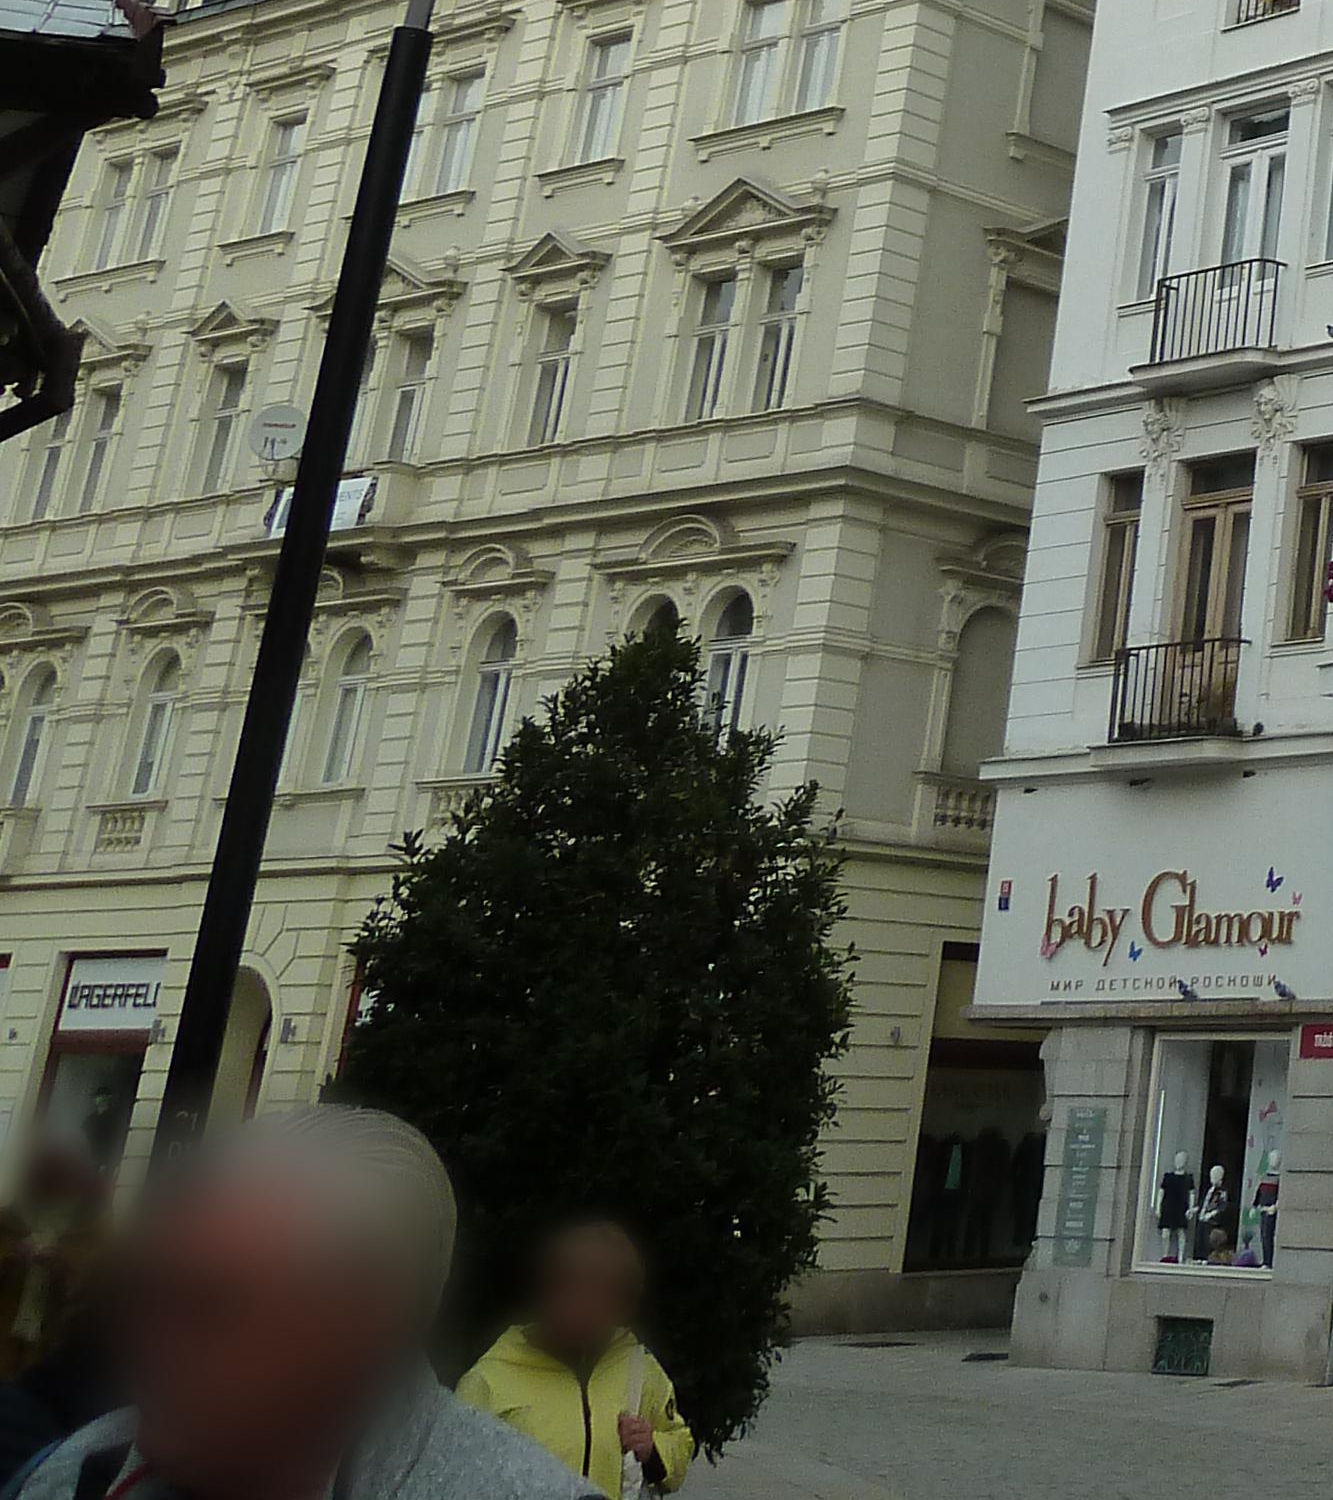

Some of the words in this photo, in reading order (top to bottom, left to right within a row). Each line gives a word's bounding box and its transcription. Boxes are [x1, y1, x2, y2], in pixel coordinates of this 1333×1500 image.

[1045, 871, 1131, 967] baby
[1141, 869, 1302, 949] Glamour
[1050, 978, 1085, 992] МИР
